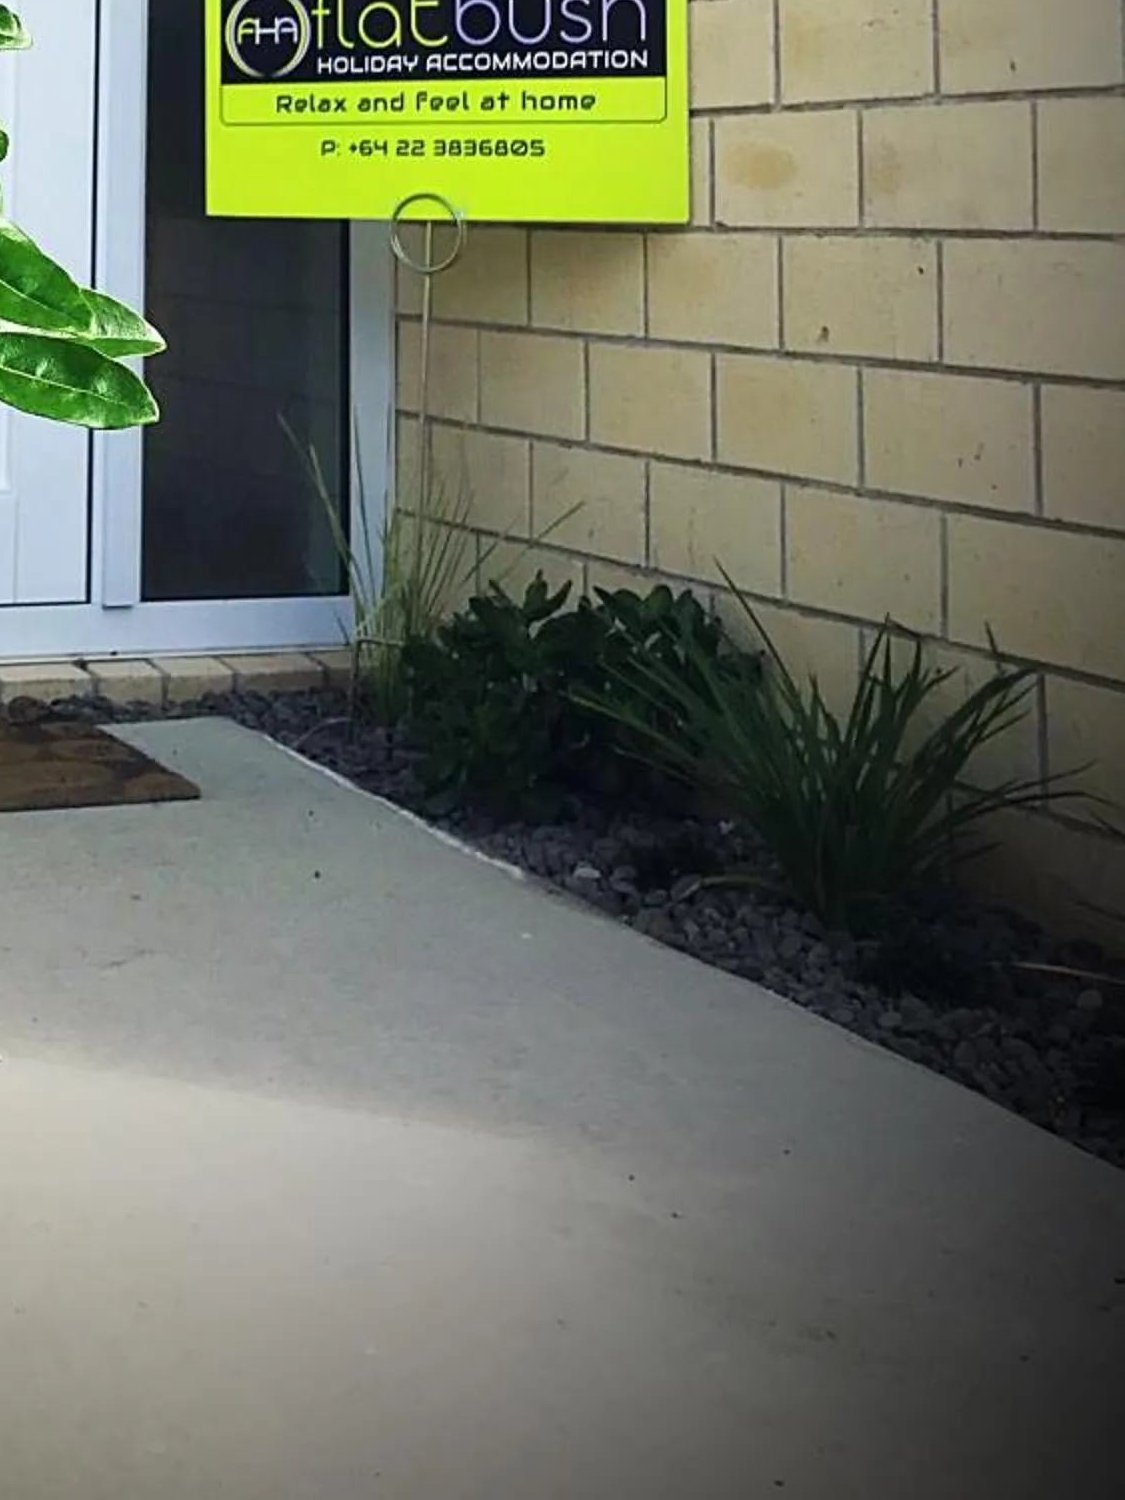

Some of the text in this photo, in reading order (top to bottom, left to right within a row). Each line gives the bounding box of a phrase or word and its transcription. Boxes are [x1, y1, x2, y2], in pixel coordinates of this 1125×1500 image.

[317, 50, 648, 74] HOLIDAY ACCOMMODATION
[276, 90, 596, 114] Relax and feel at home
[321, 140, 341, 157] P:
[396, 139, 425, 156] 22
[434, 139, 545, 157] 3836805
